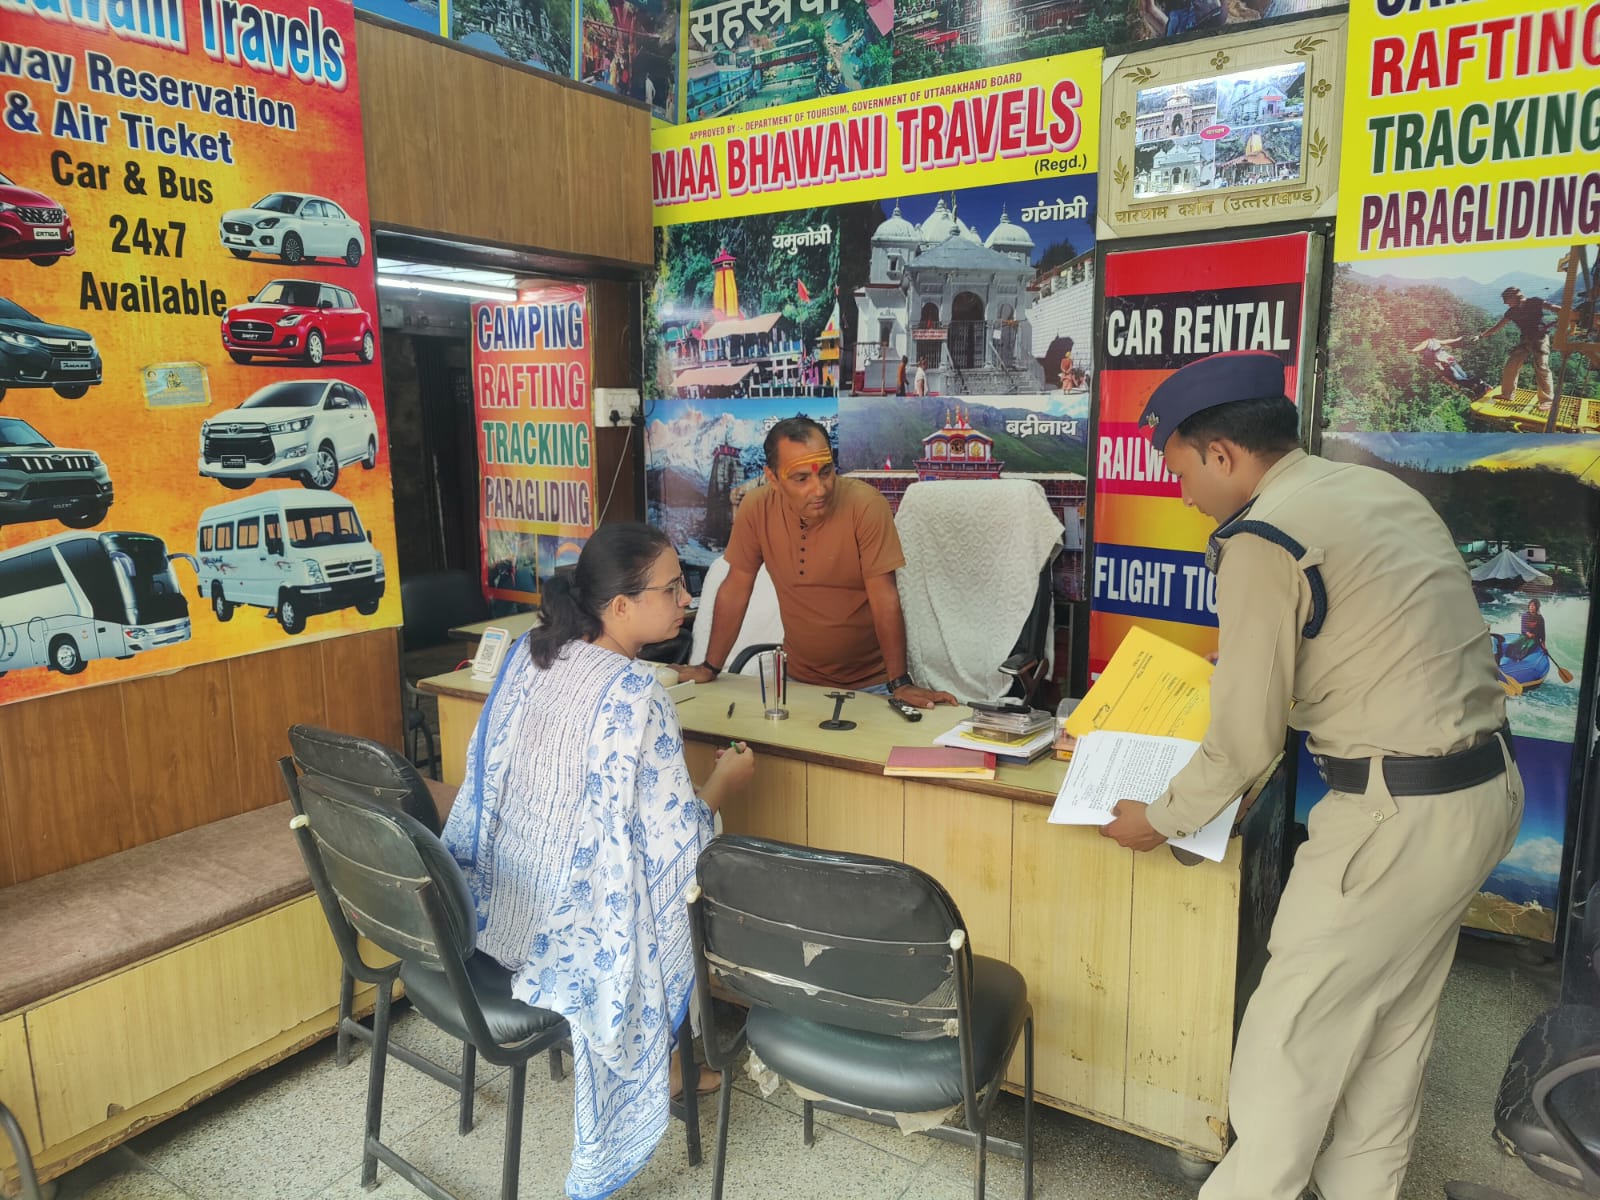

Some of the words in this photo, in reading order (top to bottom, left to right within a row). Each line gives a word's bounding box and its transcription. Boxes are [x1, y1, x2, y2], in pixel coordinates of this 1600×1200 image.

[87, 52, 296, 130] Reservation
[690, 126, 725, 140] APPROVED
[727, 124, 736, 134] BY
[745, 114, 793, 131] DEPARTMENT
[795, 112, 805, 122] OF
[806, 105, 850, 120] TOURISUM,
[852, 93, 907, 112] GOVERNMENT
[910, 91, 921, 101] OF
[924, 79, 988, 100] UTTARAKHAND
[990, 72, 1022, 87] BOARD
[7, 93, 38, 133] &
[54, 101, 109, 143] Air
[120, 112, 234, 164] Ticket
[652, 143, 717, 201] MAA
[728, 115, 883, 194] BHAWANI
[897, 81, 1079, 167] TRAVELS
[1369, 88, 1600, 174] TRACKING
[51, 151, 109, 190] Car
[124, 161, 148, 196] &
[158, 166, 214, 203] Bus
[1034, 154, 1088, 176] (Regd.)
[1021, 195, 1089, 223] गंगोत्री
[1360, 172, 1600, 251] PARAGLIDING
[109, 214, 187, 258] 24x7
[772, 224, 833, 255] यमुनोत्री
[80, 271, 228, 317] Available
[478, 302, 583, 351] CAMPING
[1107, 309, 1163, 357] CAR
[1174, 300, 1290, 354] RENTAL
[480, 362, 585, 409] RAFTING
[484, 422, 590, 468] TRACKING
[1005, 415, 1078, 438] बद्रीनाथ
[1098, 436, 1178, 483] RAILW
[486, 477, 590, 526] PARAGLIDING
[1094, 556, 1176, 608] FLIGHT
